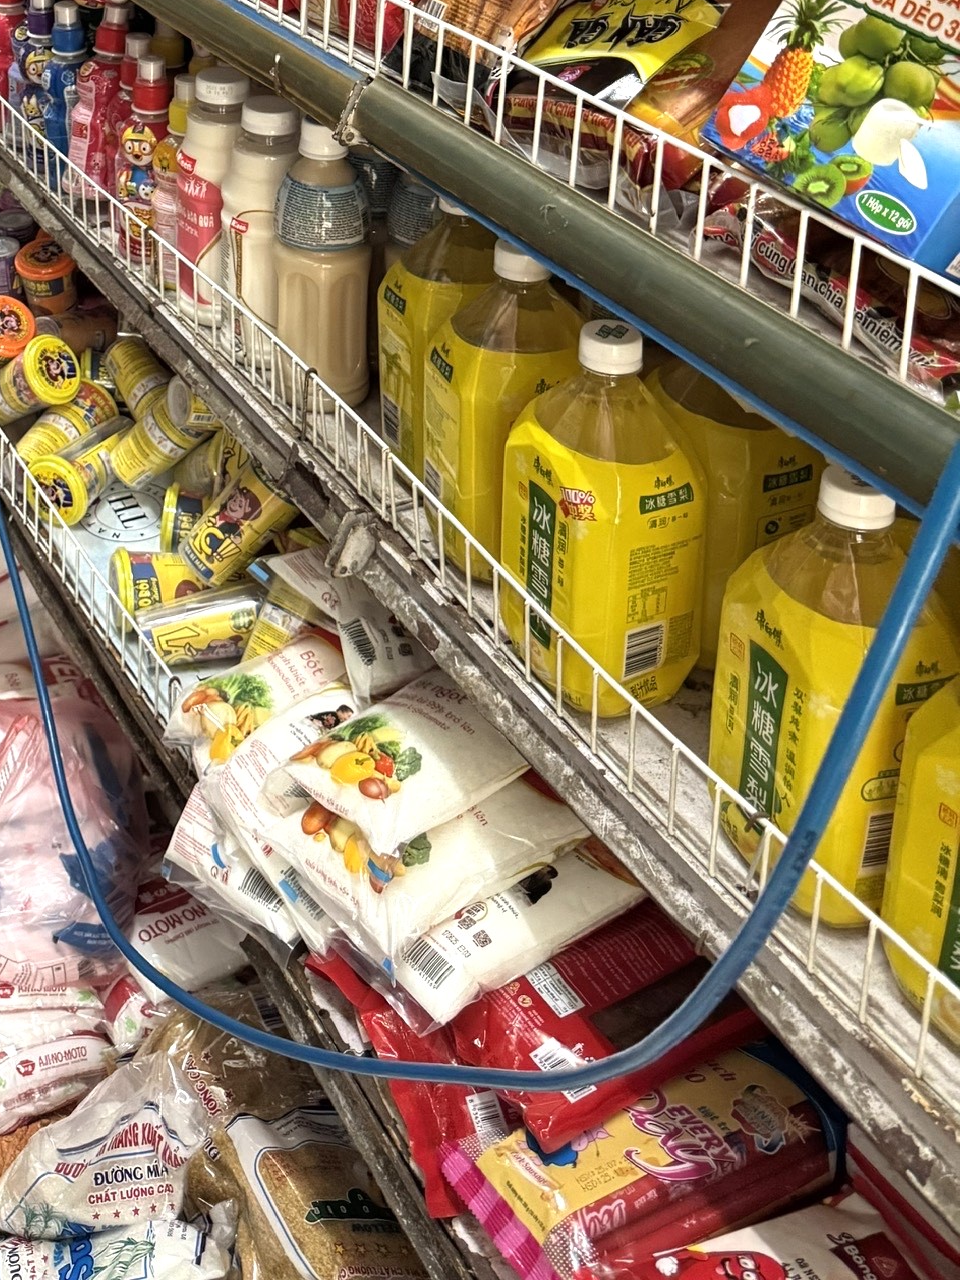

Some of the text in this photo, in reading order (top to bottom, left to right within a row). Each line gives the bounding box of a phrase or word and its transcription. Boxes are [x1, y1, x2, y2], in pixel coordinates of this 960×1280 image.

[900, 0, 945, 32] DẺO
[866, 196, 882, 216] Hộp
[896, 215, 913, 230] gói
[757, 238, 789, 272] cùng
[817, 280, 844, 309] chia
[644, 489, 690, 511] 冰糖雪梨
[299, 649, 324, 677] Bột
[38, 1045, 88, 1067] AJI-NO-MOTO
[93, 1164, 144, 1187] ĐƯỜNG
[87, 1190, 117, 1206] CHẤT
[120, 1184, 155, 1201] LƯỢNG
